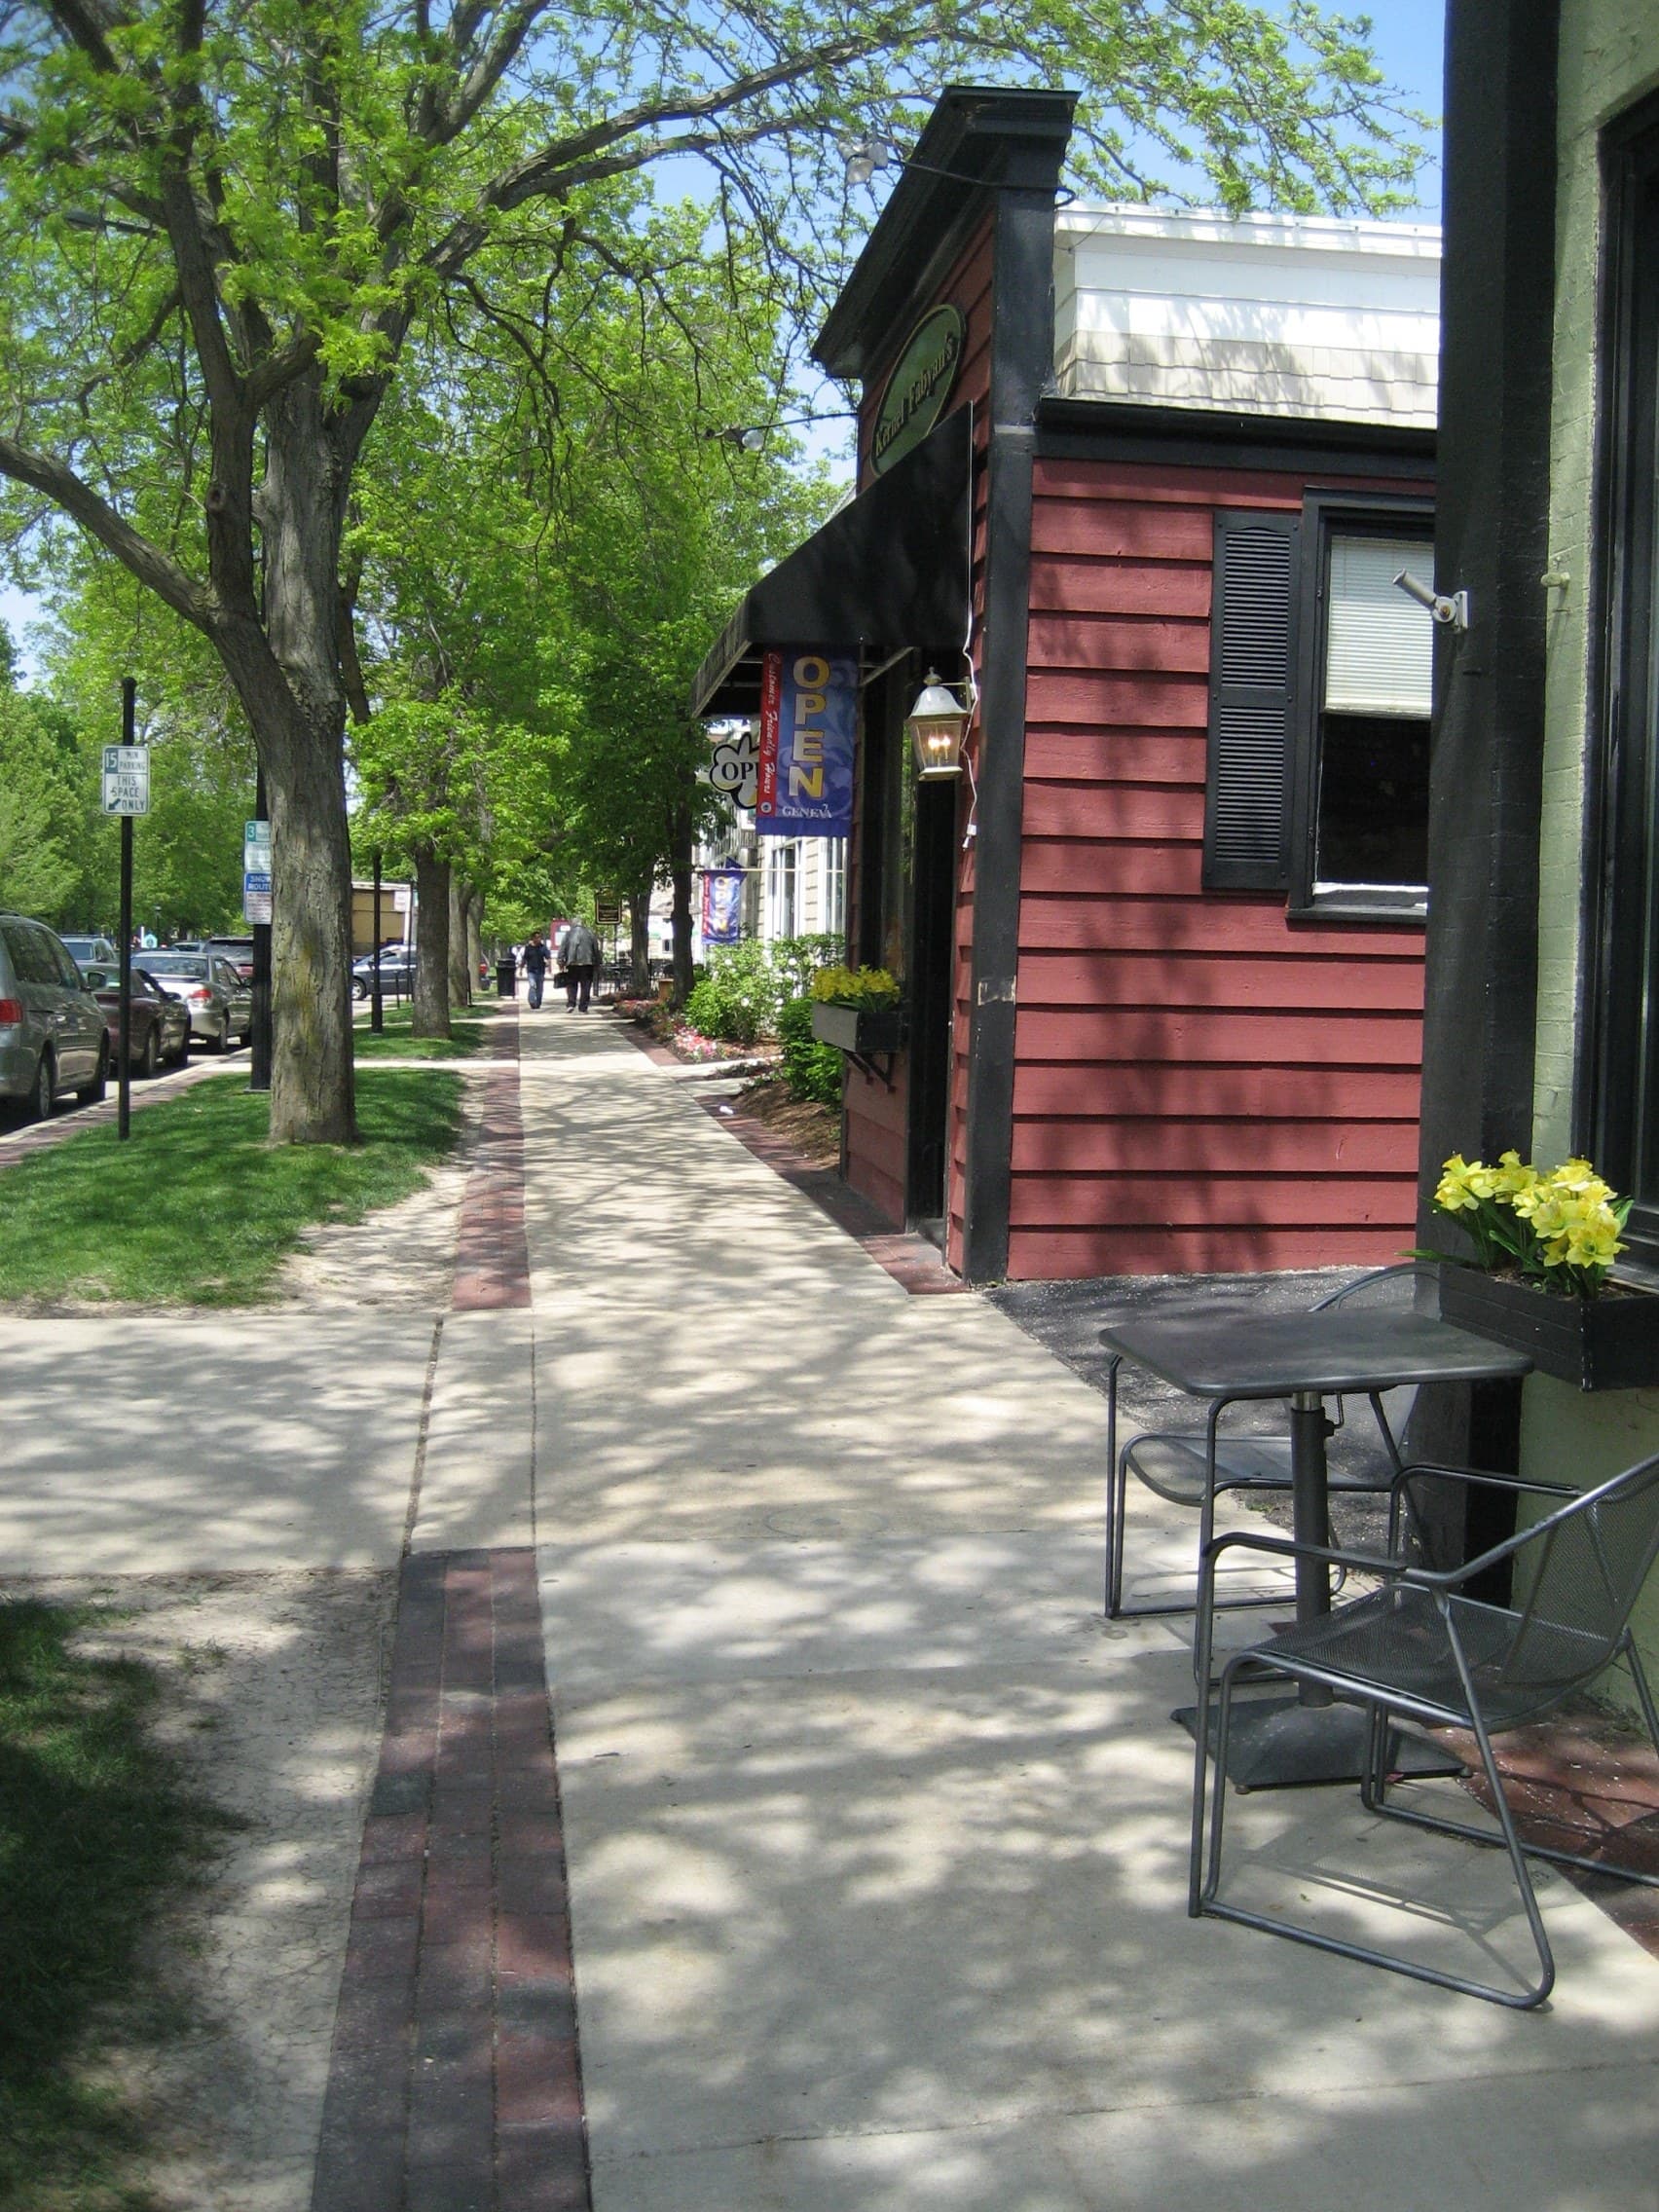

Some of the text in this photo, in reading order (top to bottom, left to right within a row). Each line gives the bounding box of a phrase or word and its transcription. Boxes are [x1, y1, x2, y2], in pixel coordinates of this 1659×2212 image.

[763, 653, 780, 794] Customer Friendly Hours
[789, 655, 830, 798] OPEN
[105, 752, 117, 768] 15
[120, 761, 146, 771] PARKING
[117, 775, 136, 786] THIS
[110, 786, 139, 797] SPACE
[122, 799, 145, 810] ONLY
[782, 804, 832, 819] GENEVA
[247, 826, 255, 838] 3
